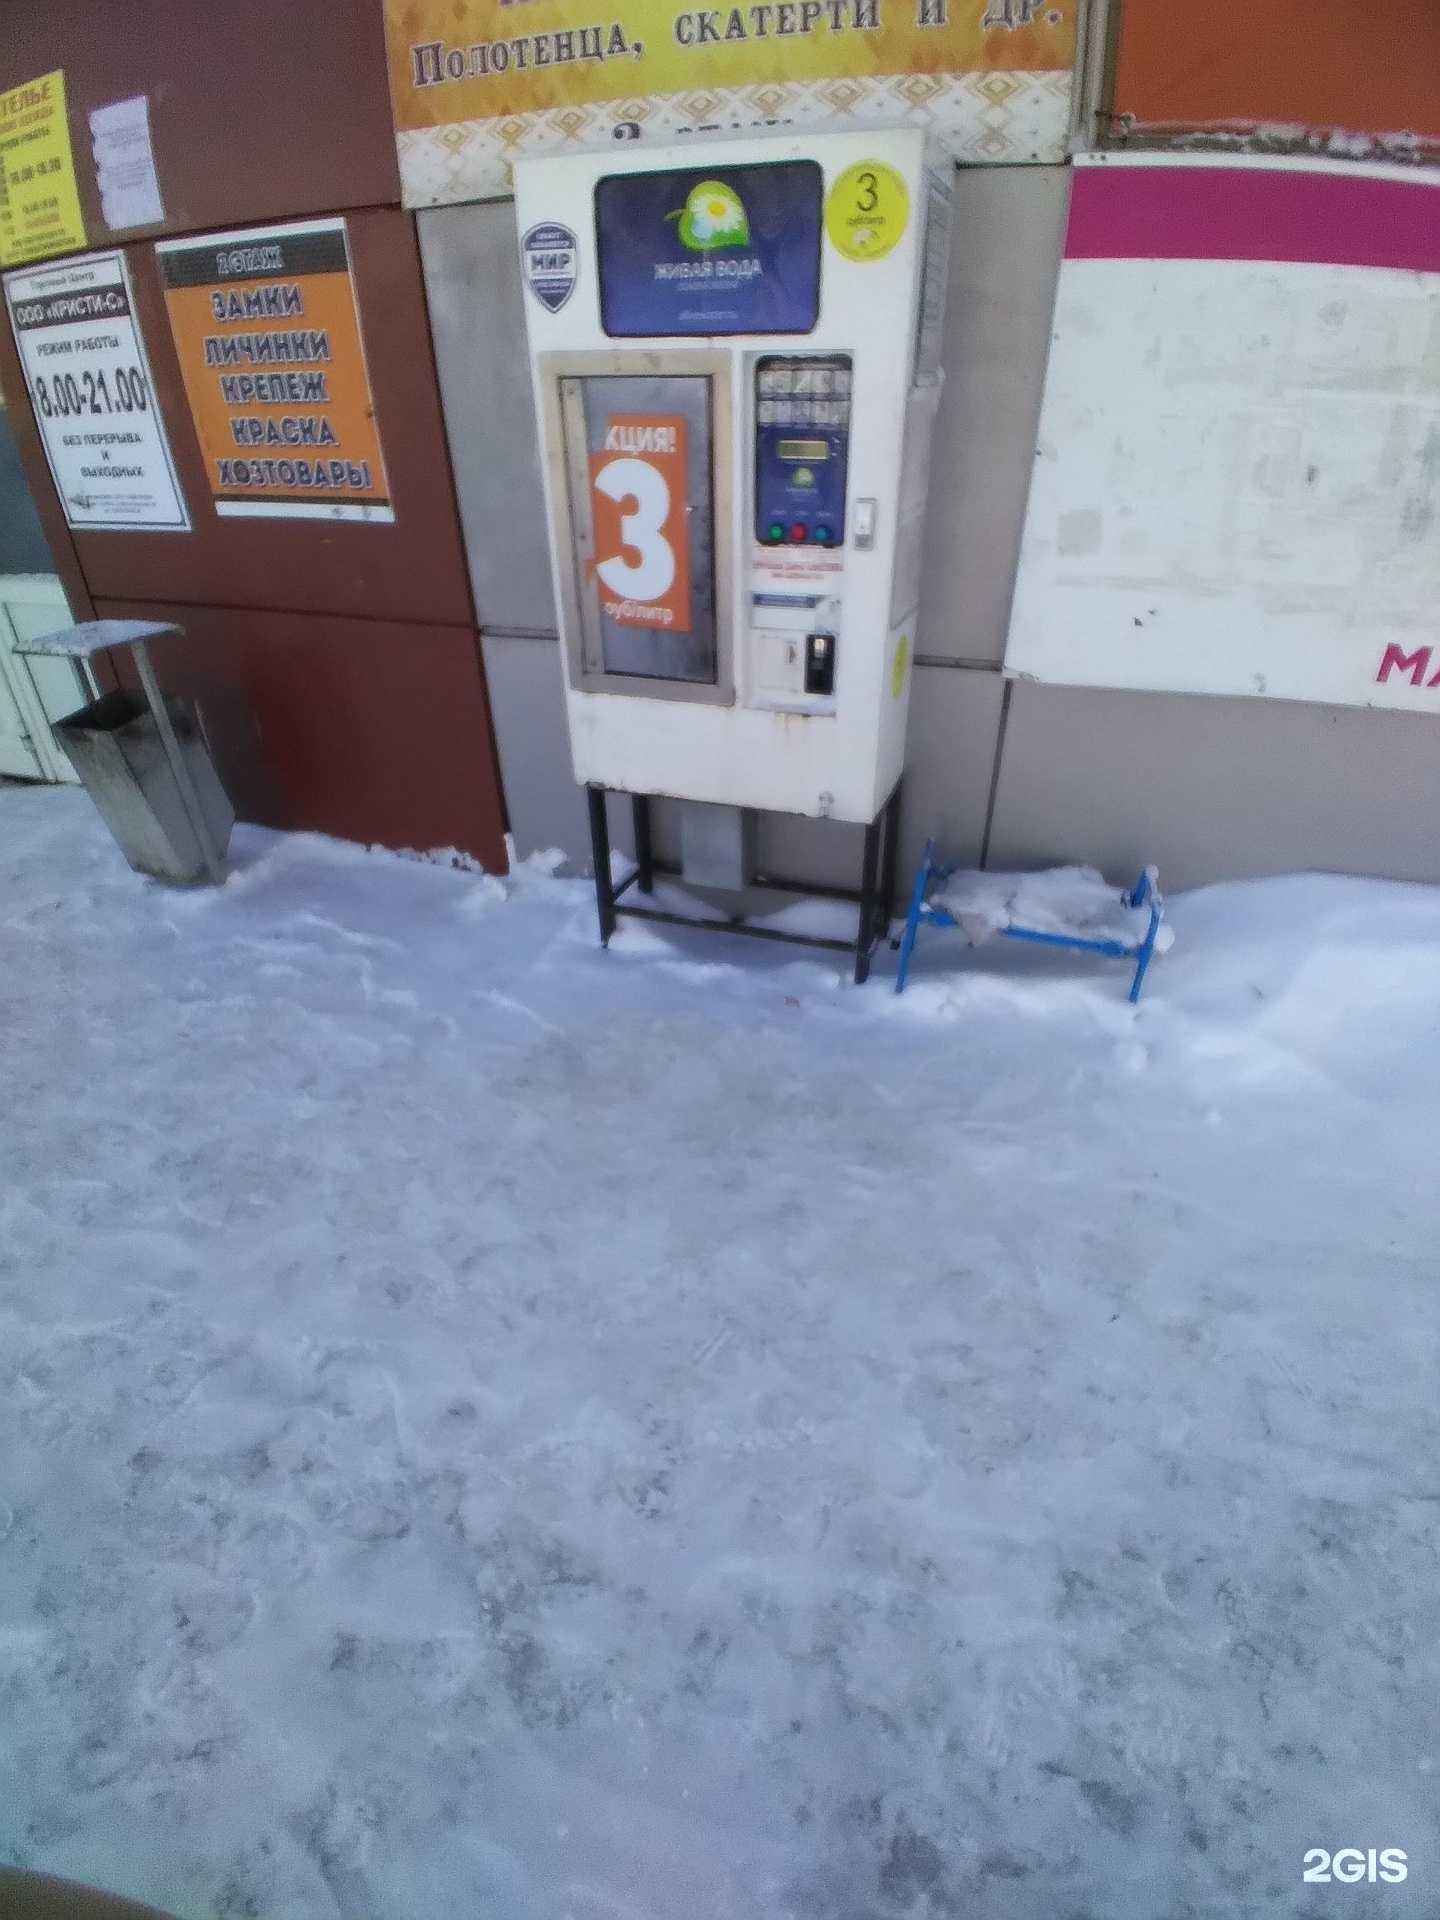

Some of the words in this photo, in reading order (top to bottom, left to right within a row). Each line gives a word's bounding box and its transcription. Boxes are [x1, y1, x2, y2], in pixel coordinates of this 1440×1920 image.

[675, 0, 880, 45] СКАТЕРТИ
[856, 172, 879, 212] 3
[654, 262, 714, 280] ЖИВАЯ
[716, 259, 763, 280] ВОДА
[16, 304, 45, 325] ООО
[211, 284, 304, 322] ЗАМКИ
[36, 341, 73, 357] РЕЖИМ
[74, 335, 120, 352] РАБОТЫ
[220, 371, 331, 405] КРЕПЕЖ
[63, 434, 83, 446] БЕЗ
[84, 432, 142, 446] ПЕРЕРЫВА
[230, 415, 342, 447] КРАСКА
[216, 458, 373, 489] ХОЗТОВАРЫ
[594, 458, 676, 601] 3
